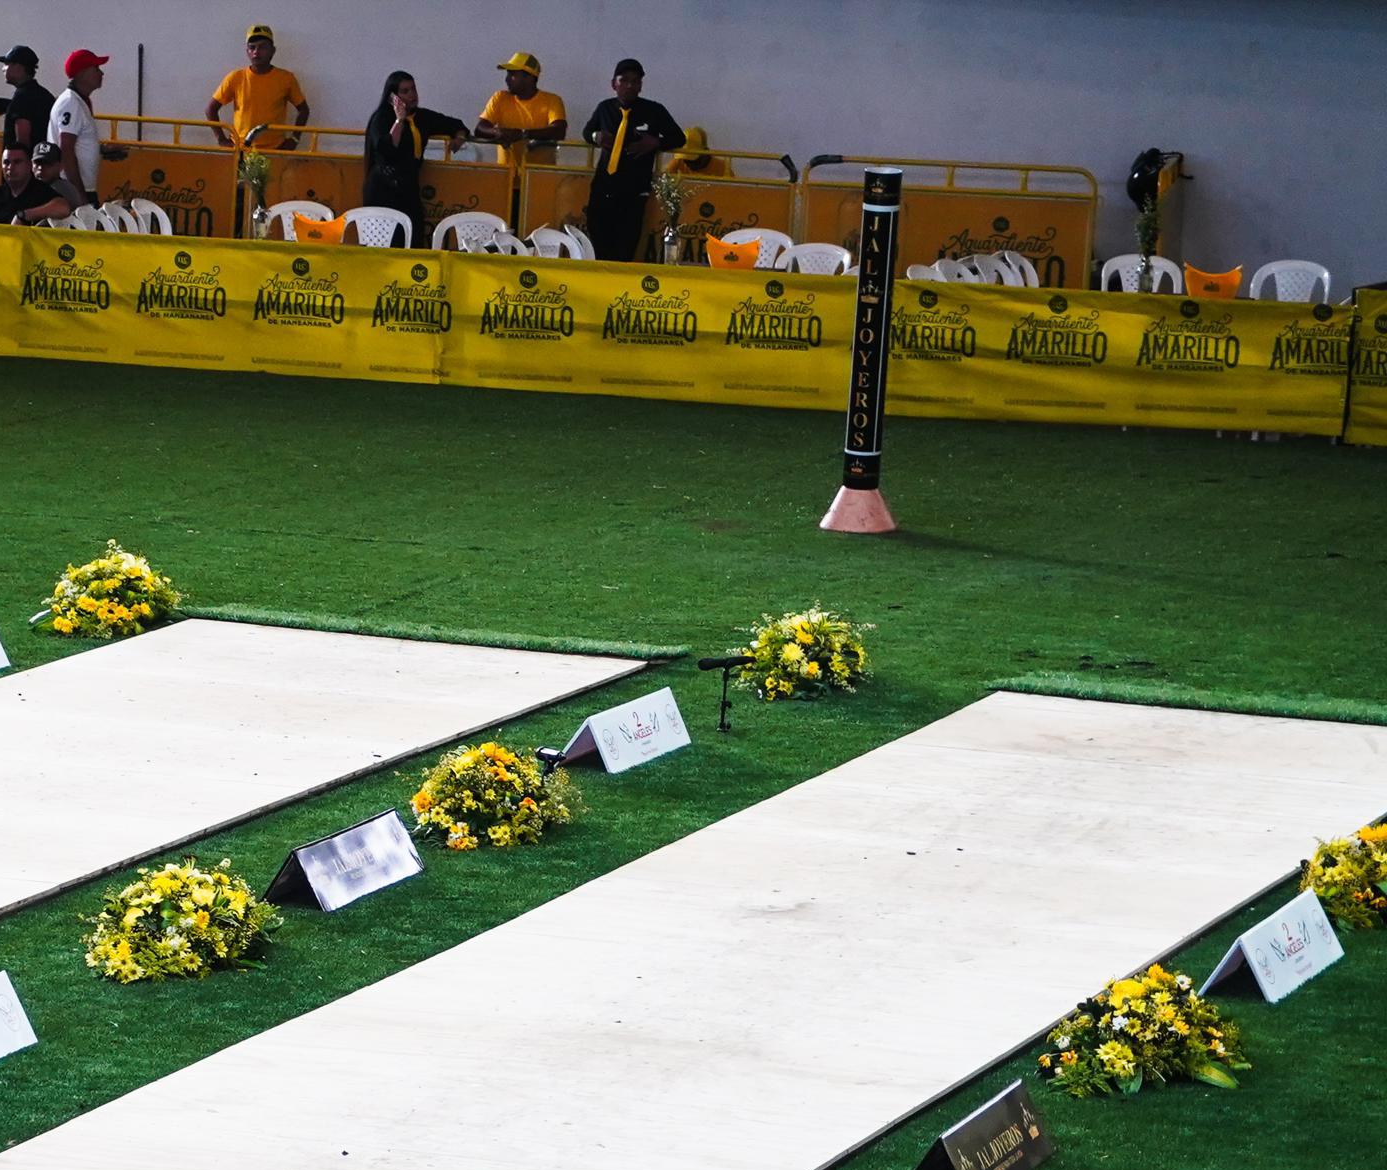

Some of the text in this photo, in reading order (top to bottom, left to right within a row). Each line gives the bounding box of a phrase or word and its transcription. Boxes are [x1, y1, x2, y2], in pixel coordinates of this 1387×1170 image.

[62, 112, 71, 126] 3
[940, 227, 1056, 254] Aguardiente
[27, 258, 104, 284] Aguardiente
[143, 266, 220, 290] Aguardiente
[261, 272, 339, 297] Aguardiente
[20, 273, 110, 310] AMARILLO
[135, 281, 226, 318] AMARILLO
[253, 288, 345, 324] AMARILLO
[487, 284, 567, 309] Aguardiente
[610, 290, 690, 313] Aguardiente
[733, 293, 815, 318] Aguardiente
[480, 302, 574, 338] AMARILLO
[602, 308, 697, 343] AMARILLO
[725, 312, 822, 348] AMARILLO
[1014, 310, 1099, 334] Aguardiente
[1144, 313, 1232, 338] Aguardiente
[1277, 321, 1350, 345] Aguardien
[890, 323, 976, 358] MARILLO
[1005, 328, 1107, 364] AMARILLO
[1135, 331, 1240, 369] AMARILLO
[1269, 336, 1348, 371] AMARIL
[851, 306, 876, 449] JOYEROS
[633, 711, 642, 727] 2
[989, 1123, 1024, 1161] JOYEROS
